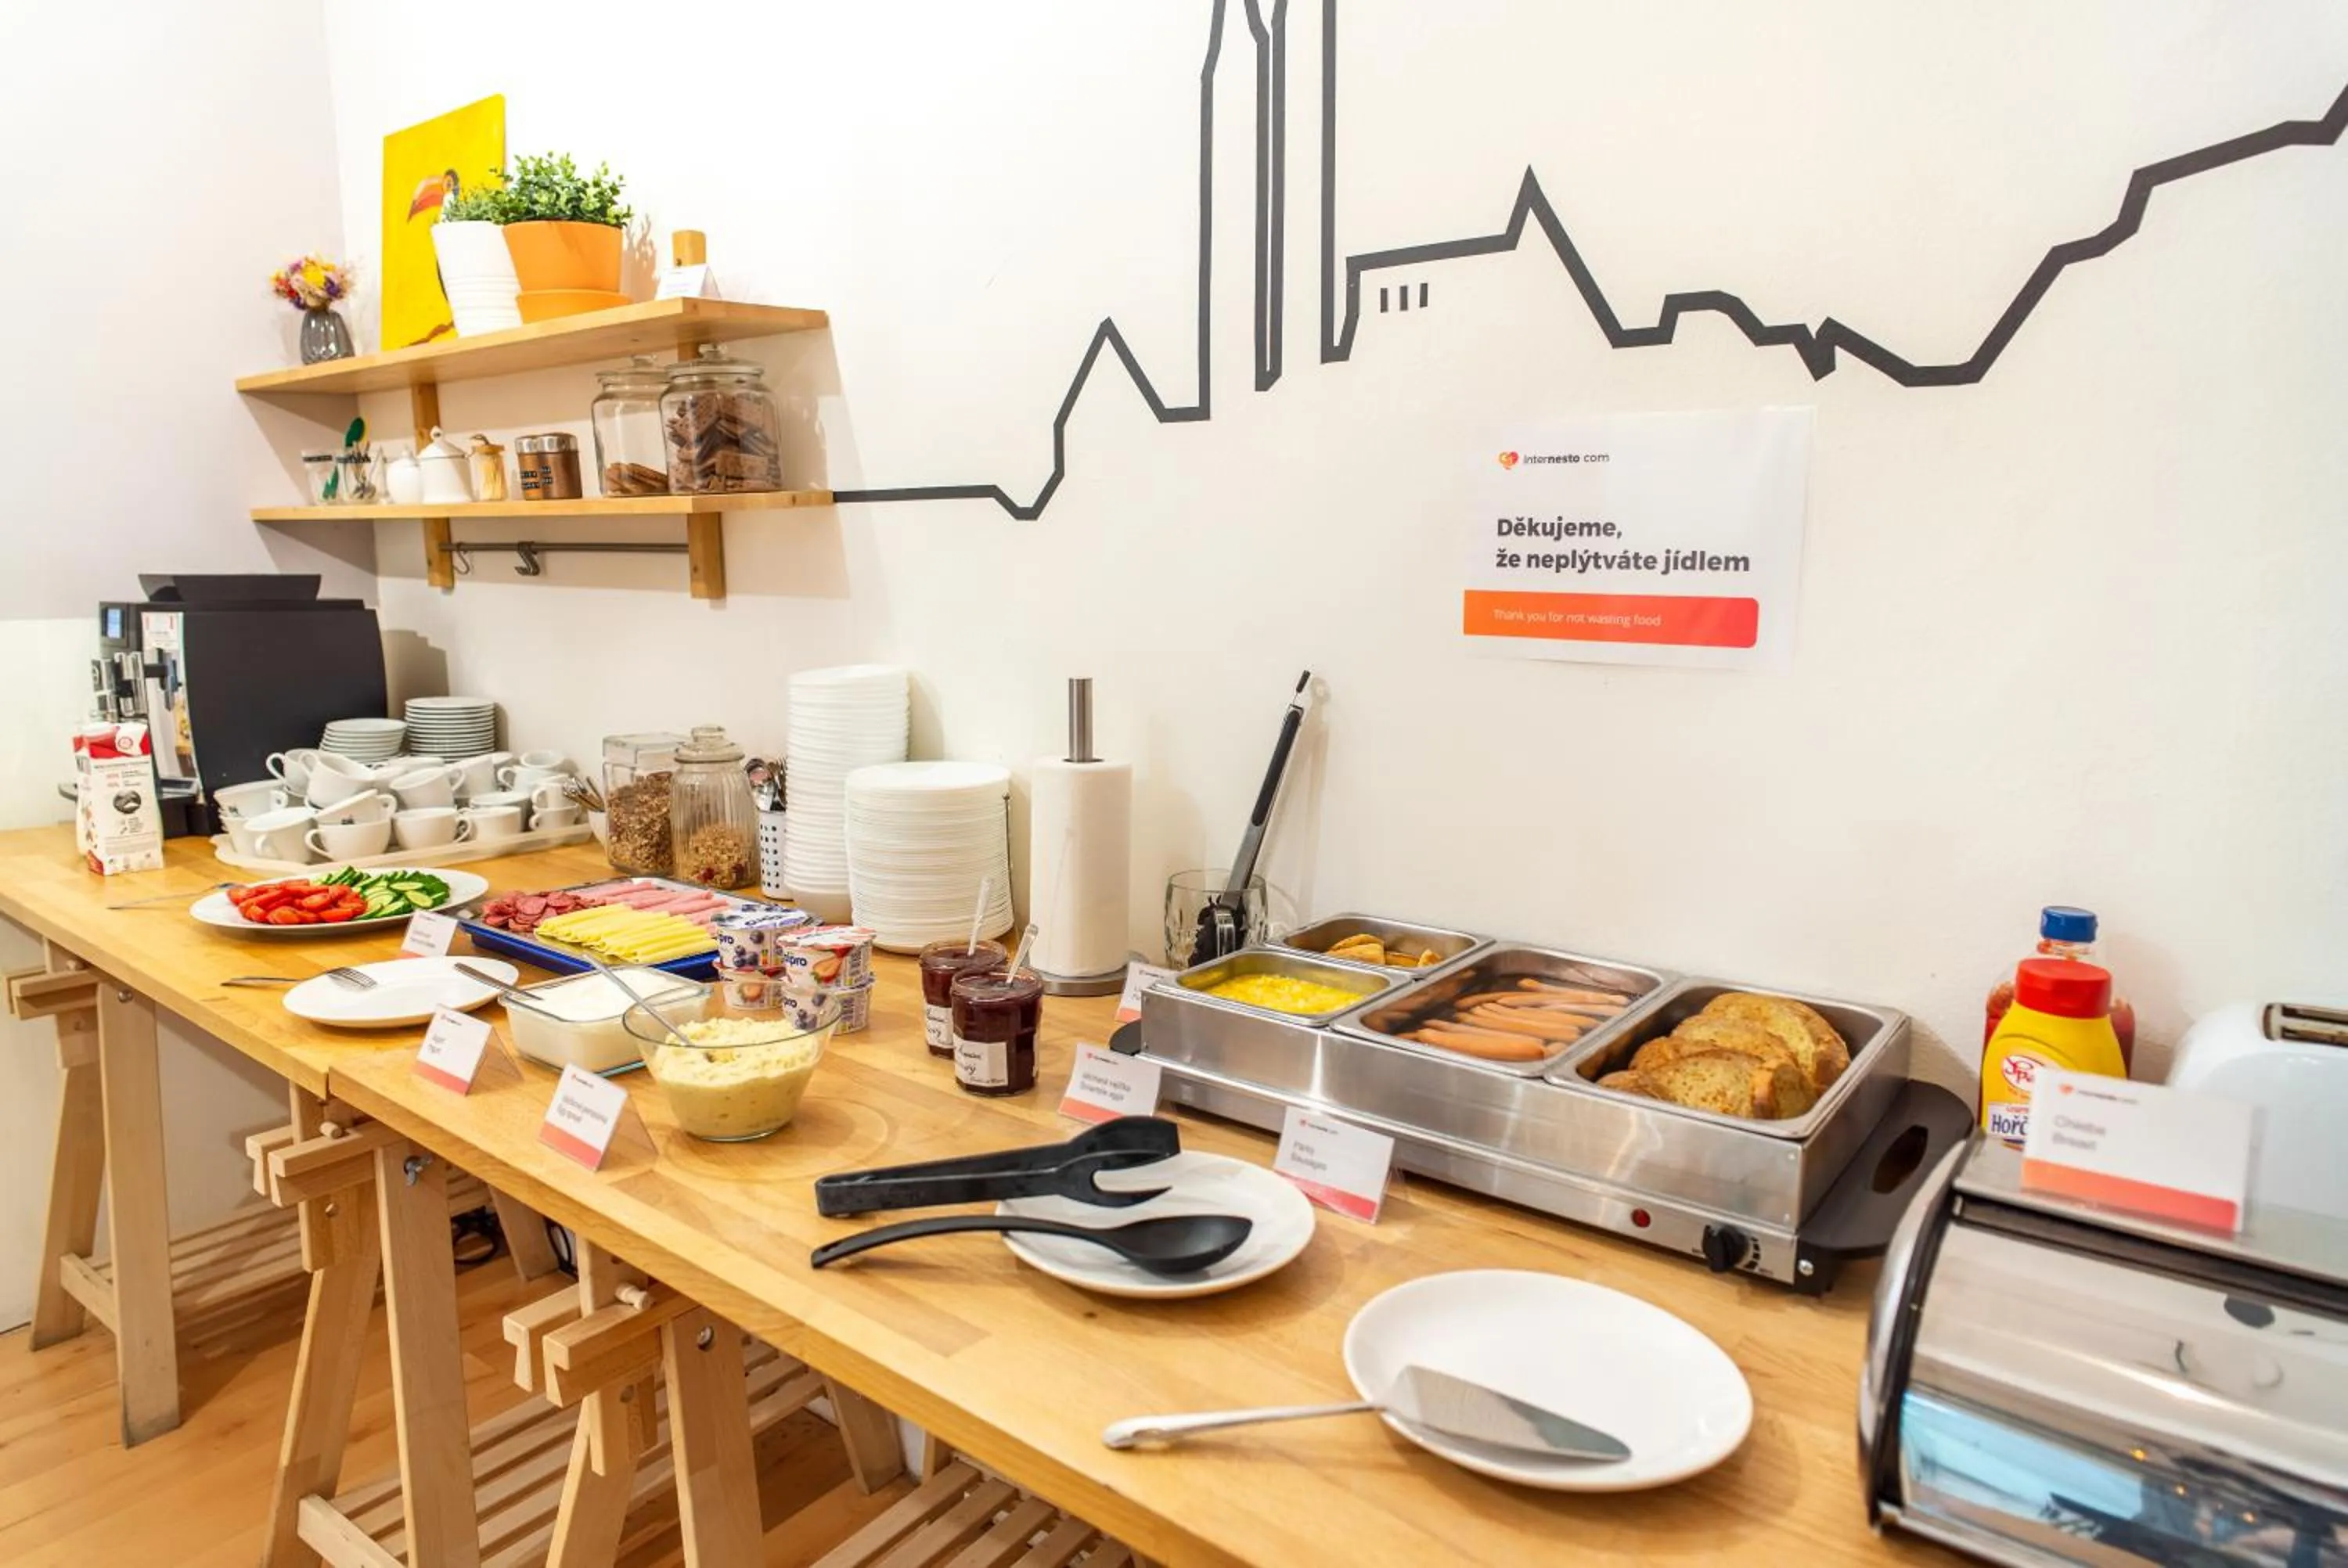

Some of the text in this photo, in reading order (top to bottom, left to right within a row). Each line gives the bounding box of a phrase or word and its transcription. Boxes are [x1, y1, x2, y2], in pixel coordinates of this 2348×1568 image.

[1496, 516, 1622, 541] Děkujeme,
[1496, 548, 1750, 575] že neplýtváte jídlem
[1493, 608, 1662, 628] Thank you for not wasting food
[1990, 1114, 2029, 1136] Hořč
